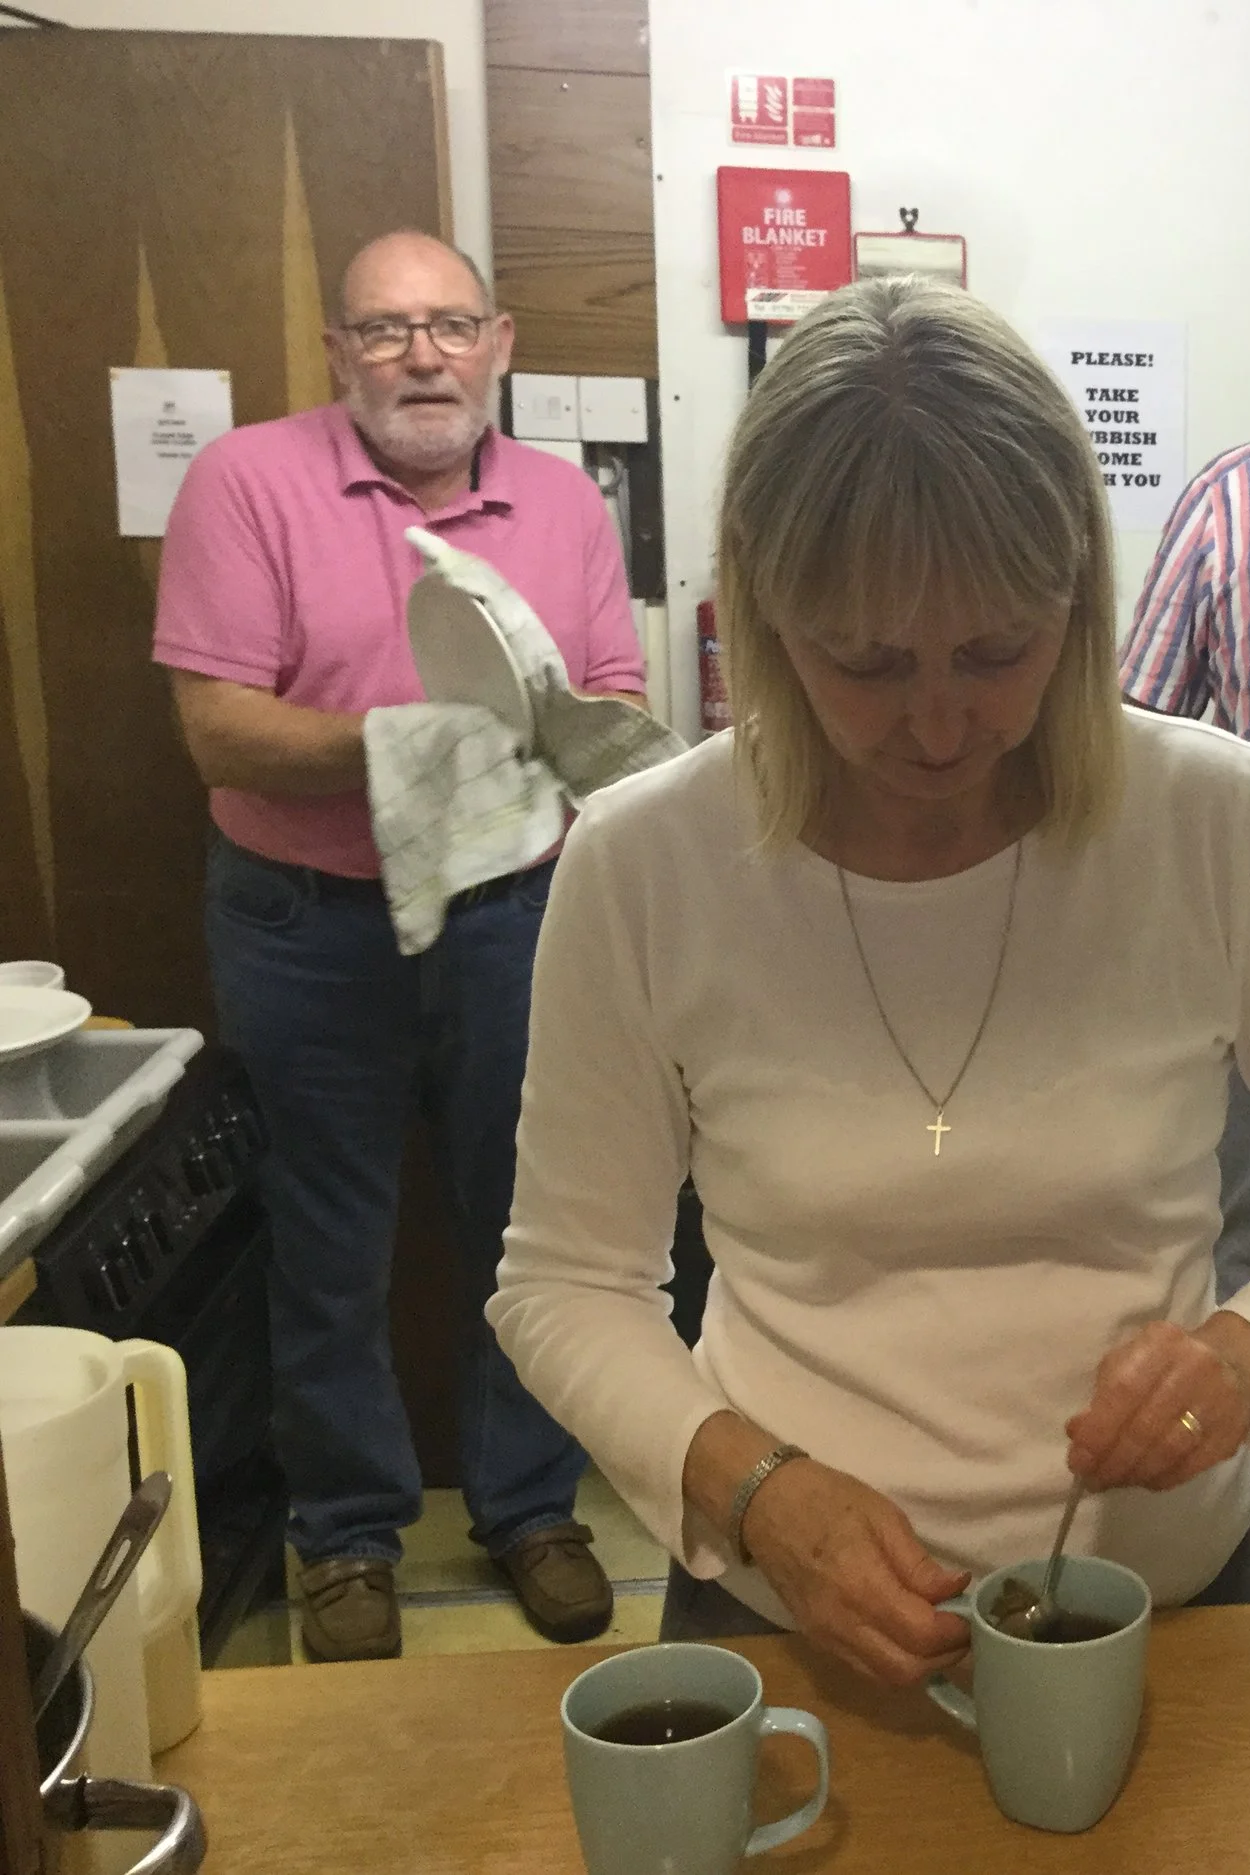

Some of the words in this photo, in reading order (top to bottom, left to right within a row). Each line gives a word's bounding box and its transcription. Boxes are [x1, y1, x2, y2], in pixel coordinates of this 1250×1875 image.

[763, 208, 807, 226] FIRE
[742, 226, 827, 247] BLANKET
[1071, 351, 1154, 367] PLEASE!
[1086, 388, 1139, 402] TAKE
[1086, 410, 1140, 423] YOUR
[1090, 431, 1157, 445] BBISH
[1098, 452, 1142, 466] OME
[1121, 473, 1161, 487] YOU
